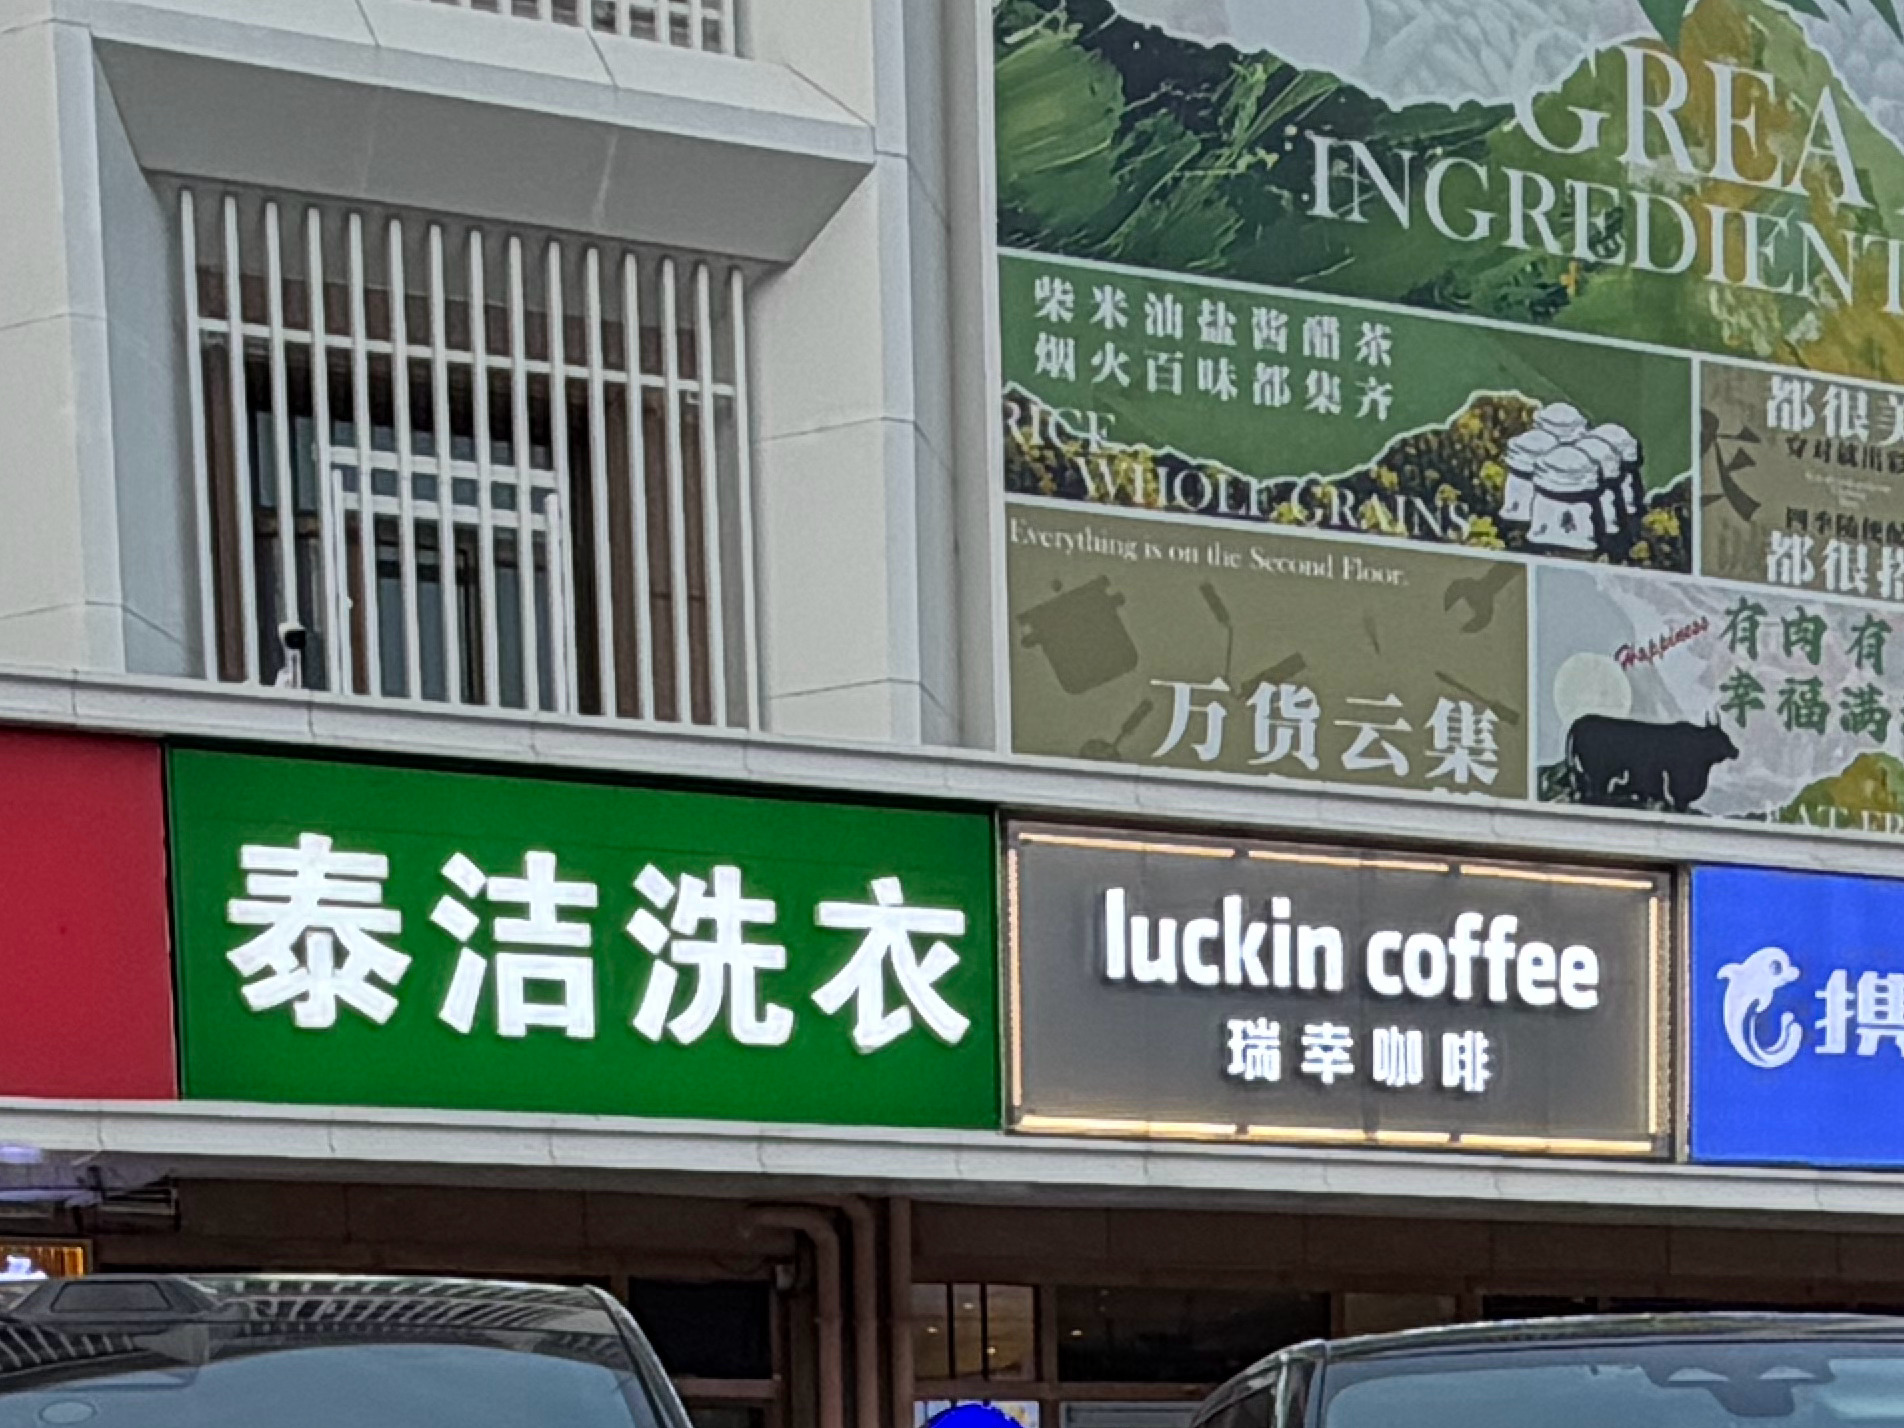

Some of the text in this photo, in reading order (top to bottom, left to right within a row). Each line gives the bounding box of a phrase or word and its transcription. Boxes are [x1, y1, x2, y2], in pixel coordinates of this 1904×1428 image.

[1033, 275, 1393, 367] 柴米油盐酱醋茶
[1033, 332, 1393, 422] 烟火百味都集齐
[1009, 517, 1410, 587] Everything is on the Second Floor.
[1289, 476, 1472, 540] GRAINS
[1613, 615, 1710, 670] Happiness
[1150, 677, 1500, 786] 万货云集
[225, 831, 971, 1055] 泰洁洗衣
[1104, 887, 1600, 1010] luckin coffee
[1225, 1015, 1494, 1093] 瑞幸咖啡
